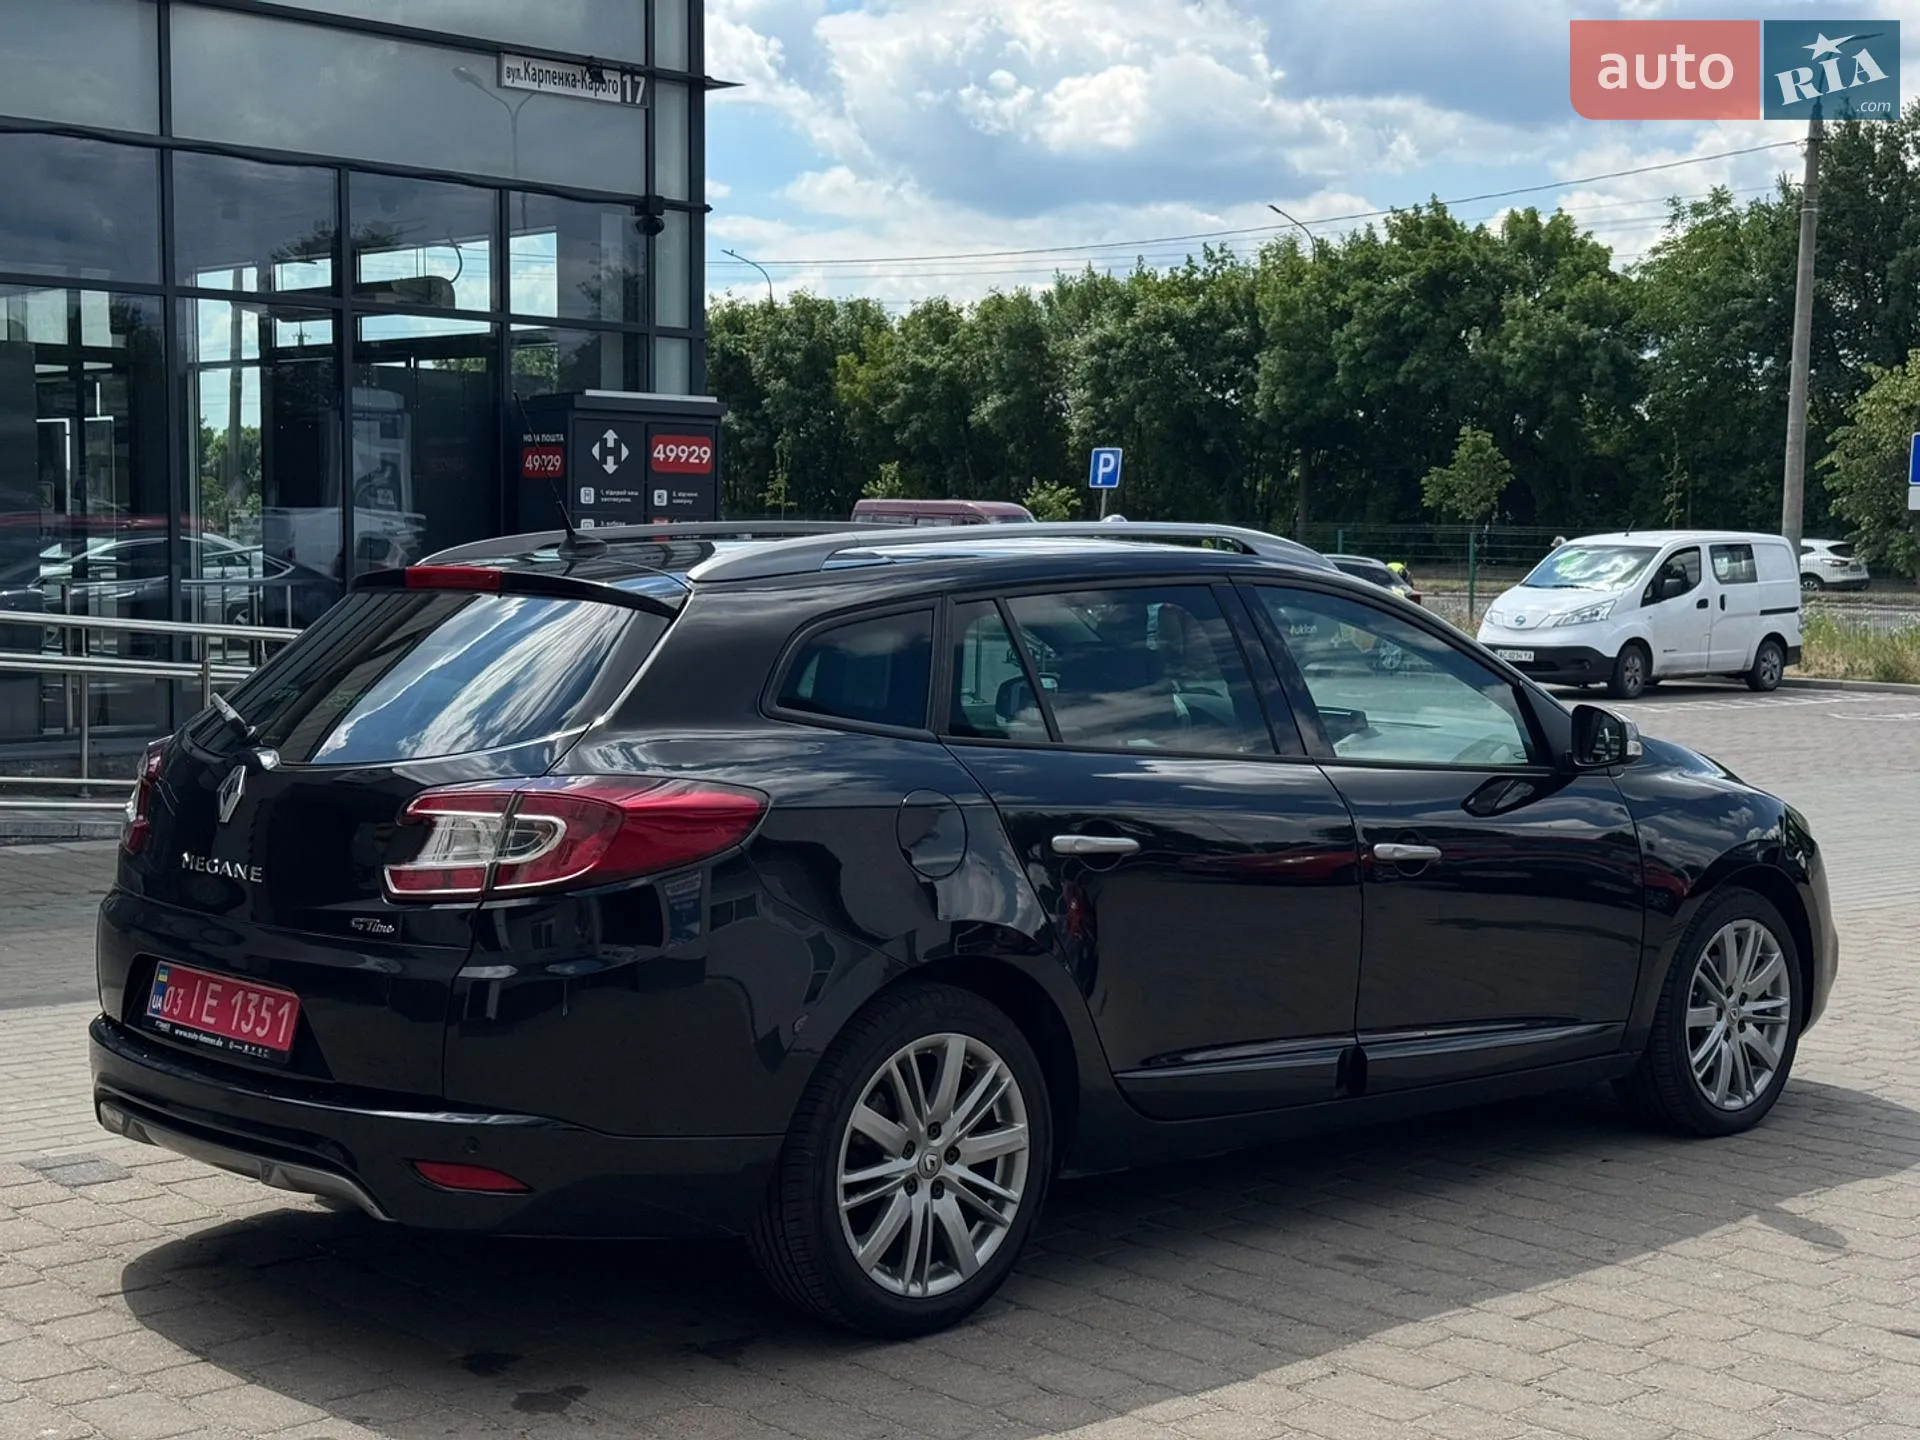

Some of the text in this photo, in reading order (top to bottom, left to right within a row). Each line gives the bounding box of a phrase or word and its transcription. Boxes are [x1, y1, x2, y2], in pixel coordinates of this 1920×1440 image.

[622, 74, 646, 104] 17
[653, 443, 711, 465] 49929
[1097, 453, 1115, 485] P
[181, 851, 263, 883] MEGANE
[152, 979, 293, 1043] UA 03 IE 1351
